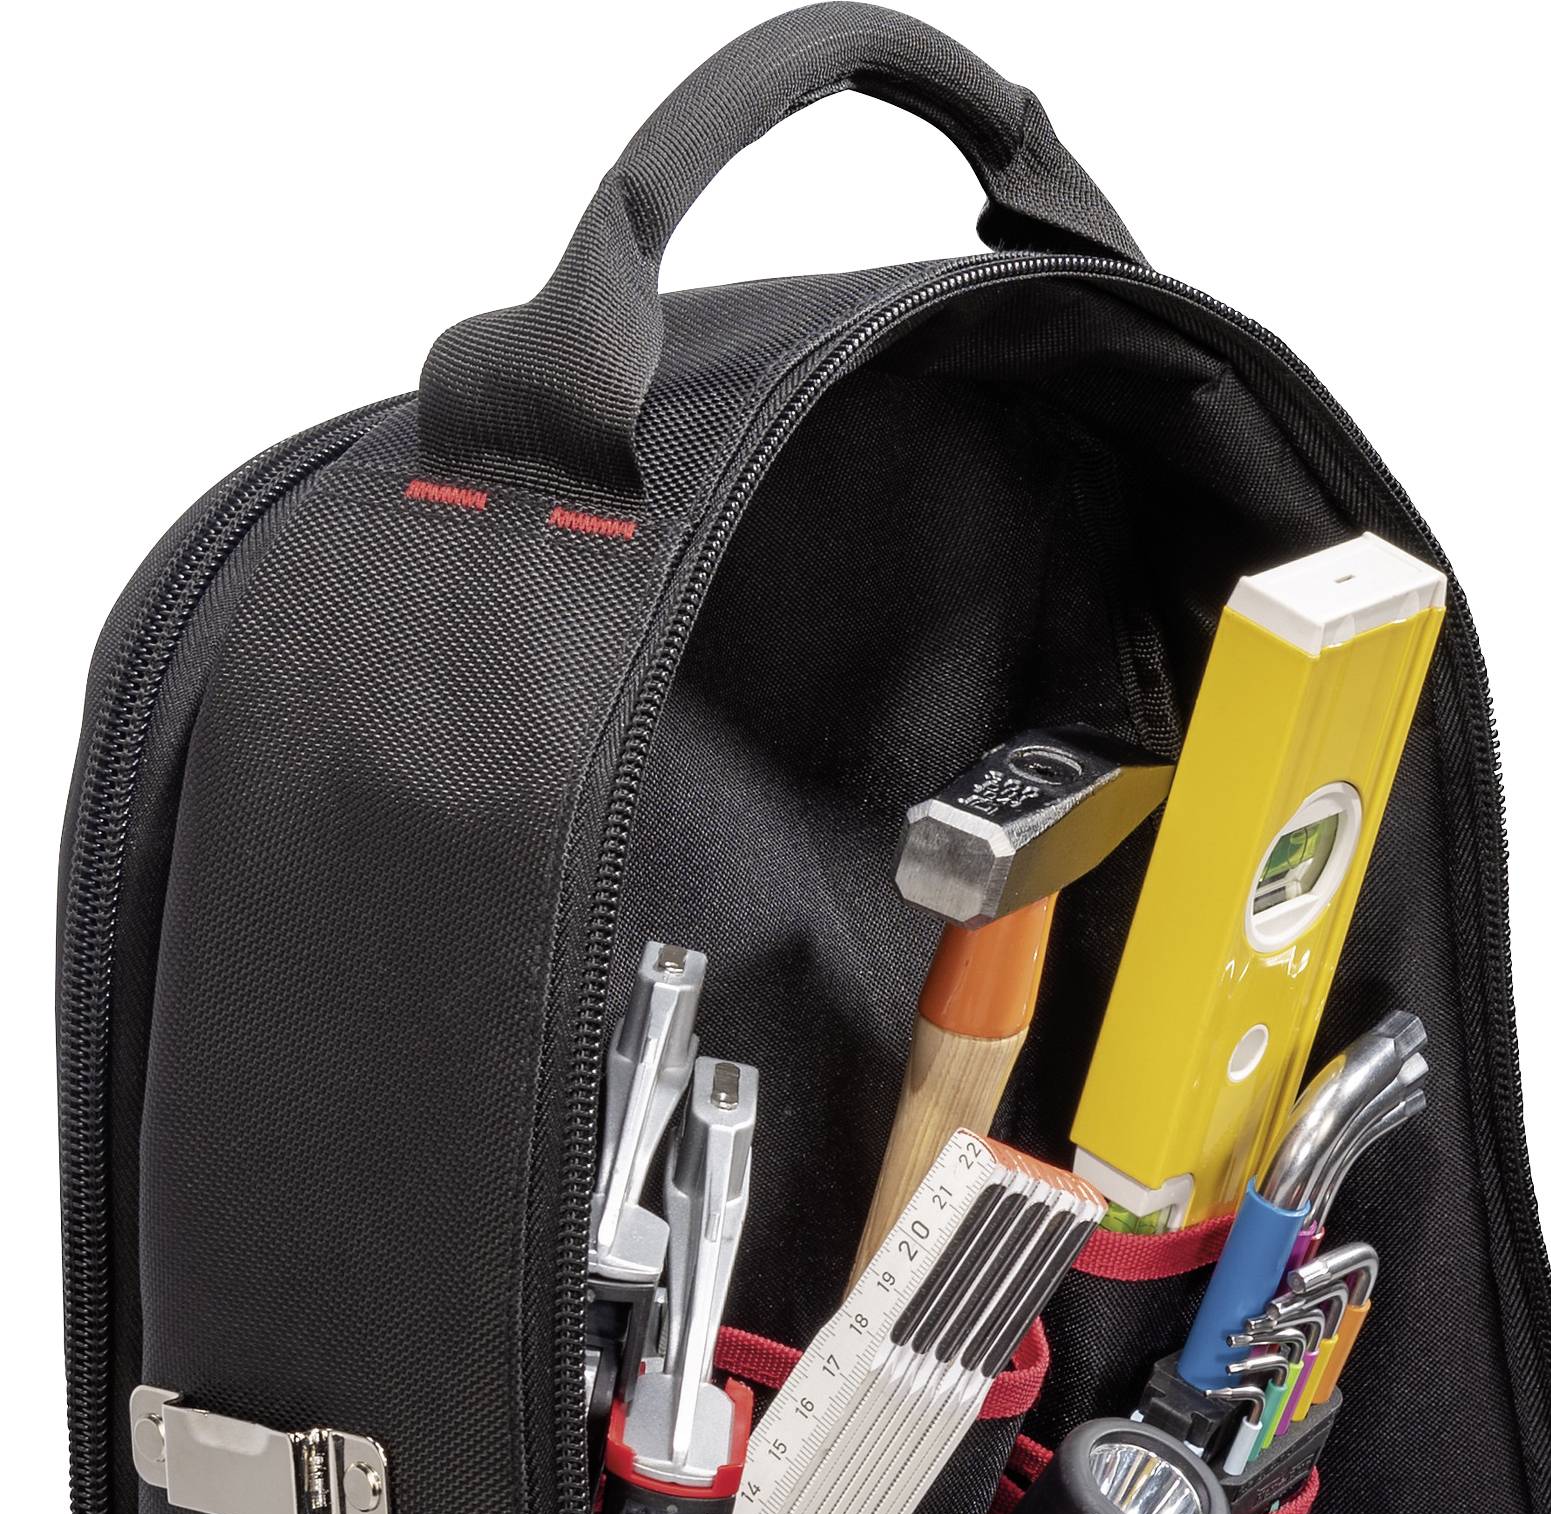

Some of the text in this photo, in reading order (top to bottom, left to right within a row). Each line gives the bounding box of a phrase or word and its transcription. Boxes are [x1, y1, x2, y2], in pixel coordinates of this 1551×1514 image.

[958, 1141, 982, 1170] 22
[931, 1185, 954, 1210] 21
[898, 1219, 930, 1262] 20
[876, 1271, 897, 1293] 19
[849, 1313, 869, 1336] 18
[821, 1354, 841, 1377] 17
[795, 1396, 815, 1420] 16
[767, 1438, 787, 1461] 15
[740, 1481, 761, 1503] 14
